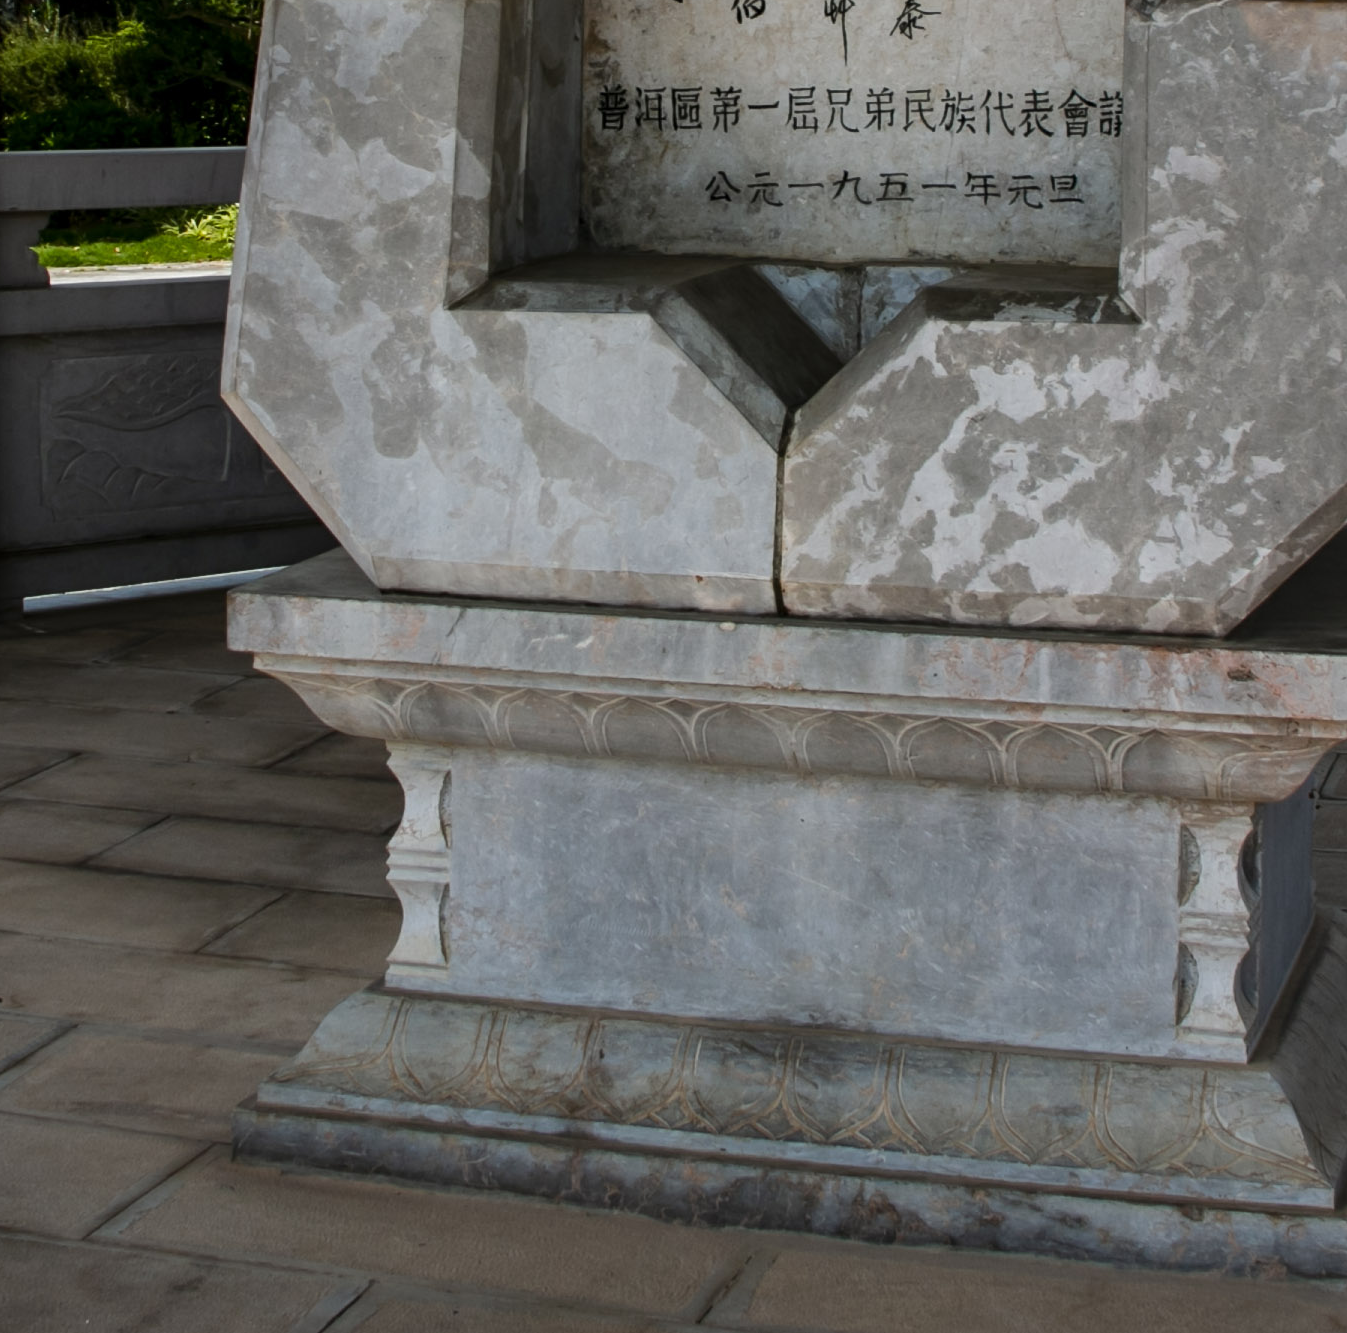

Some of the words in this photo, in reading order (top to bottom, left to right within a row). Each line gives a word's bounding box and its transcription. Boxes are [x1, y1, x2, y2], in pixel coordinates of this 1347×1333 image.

[704, 170, 1086, 209] 公元一九五一年元旦
